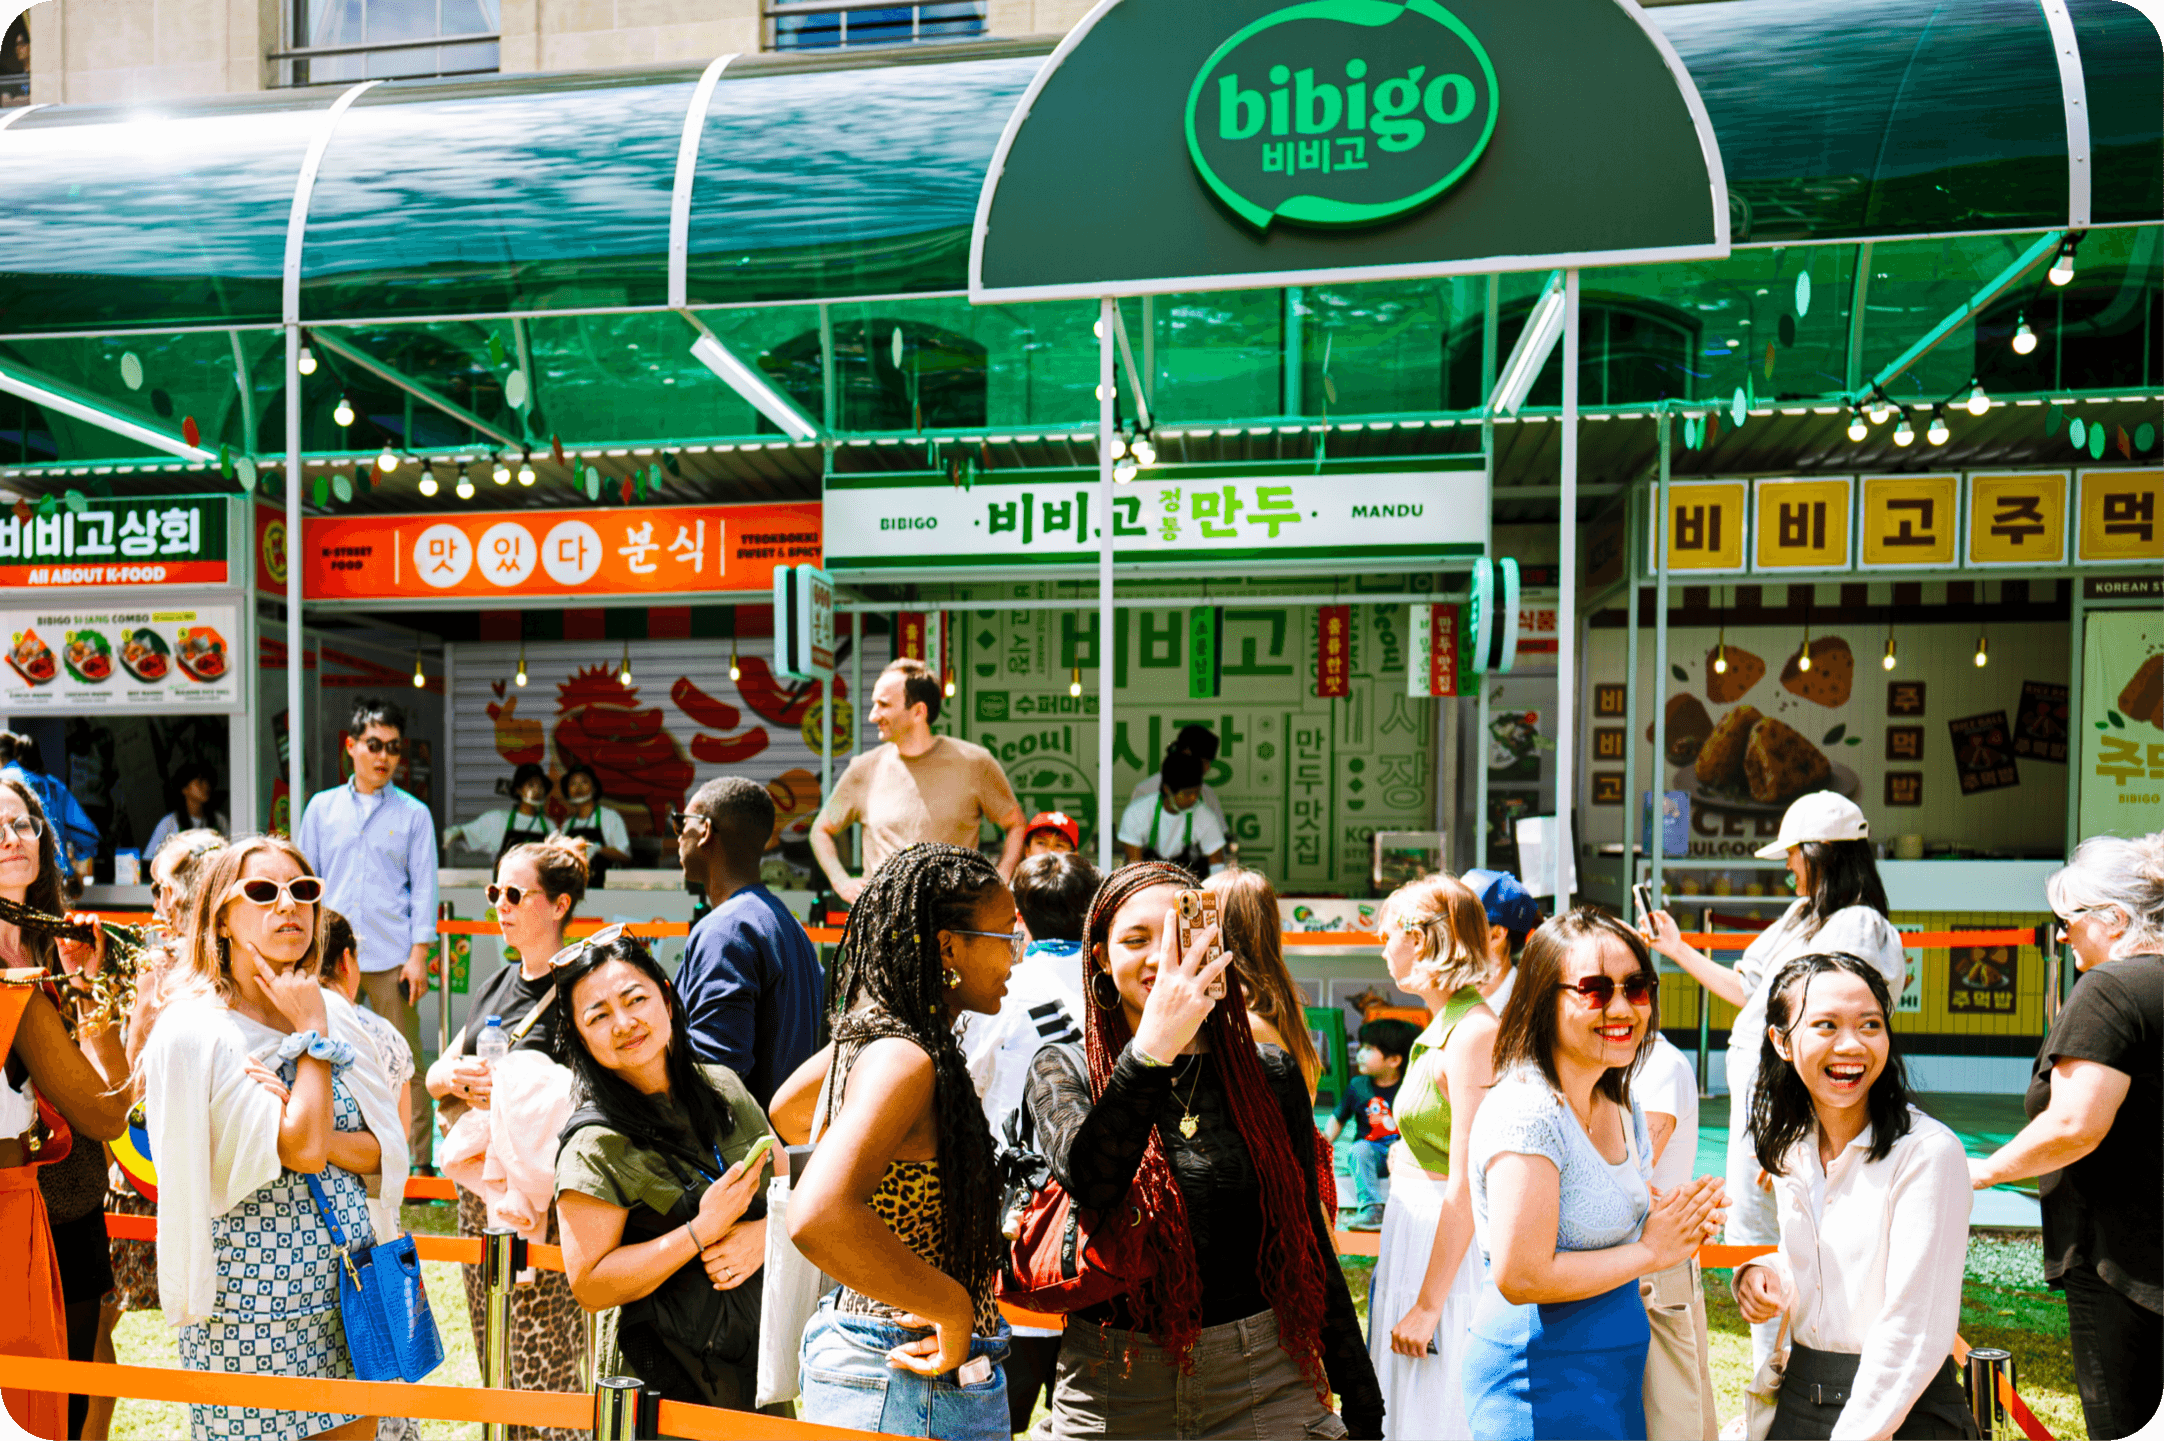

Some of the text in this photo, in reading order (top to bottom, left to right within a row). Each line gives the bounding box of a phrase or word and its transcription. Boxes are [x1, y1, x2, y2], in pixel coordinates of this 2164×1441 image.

[1218, 58, 1477, 153] bibigo
[1261, 136, 1369, 176] 비비고
[1190, 485, 1301, 539] 만두
[1351, 504, 1424, 518] MANDU
[880, 517, 938, 531] BIBIGO
[330, 560, 364, 571] FOOD
[51, 567, 103, 583] ABOUT
[106, 566, 167, 582] K-FOOD
[2095, 581, 2149, 593] KOREAN
[37, 616, 71, 626] BIBIGO
[111, 613, 150, 624] COMBO
[980, 724, 1072, 763] Seoul
[1598, 688, 1624, 801] 비비고
[1294, 727, 1326, 866] 만두맛집
[2118, 793, 2161, 804] BIBIGO
